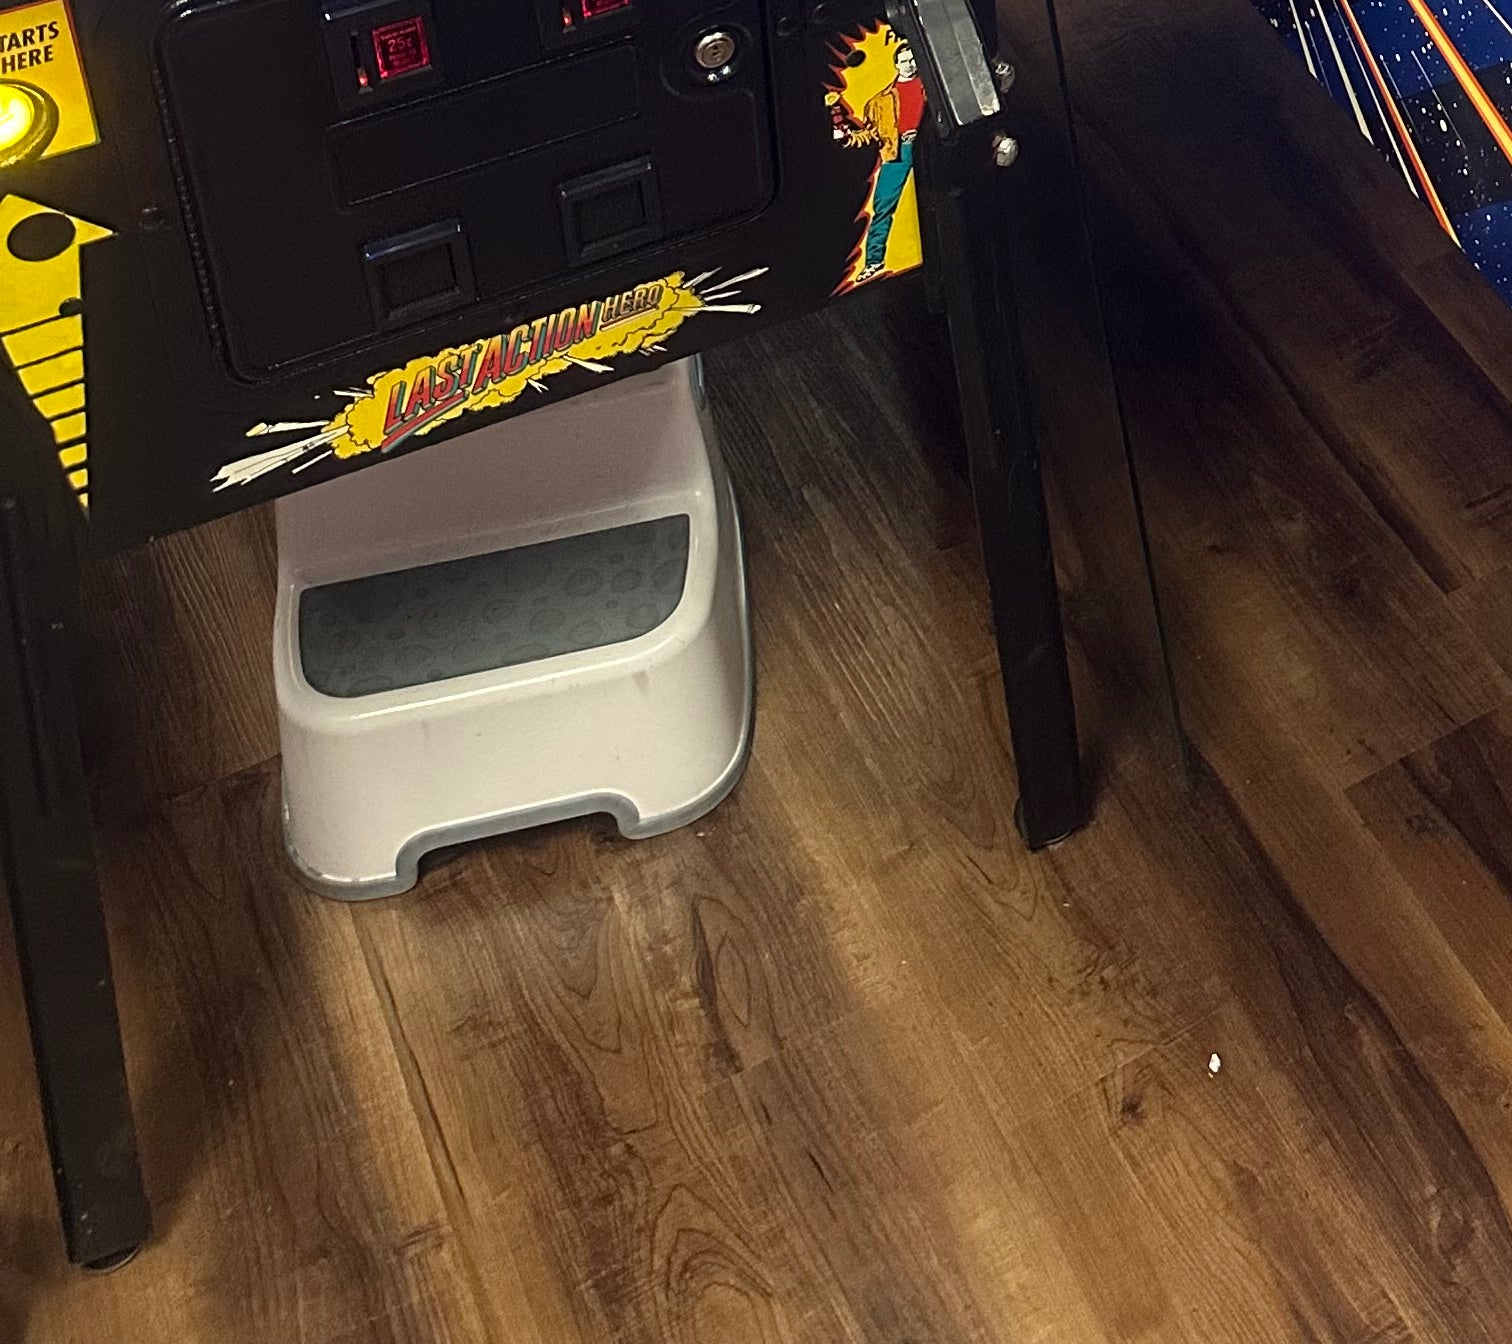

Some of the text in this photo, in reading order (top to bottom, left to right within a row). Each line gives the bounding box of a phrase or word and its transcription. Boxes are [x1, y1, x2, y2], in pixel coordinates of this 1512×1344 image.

[1, 44, 54, 75] HERE
[384, 284, 664, 434] LAST ACTION HERO
